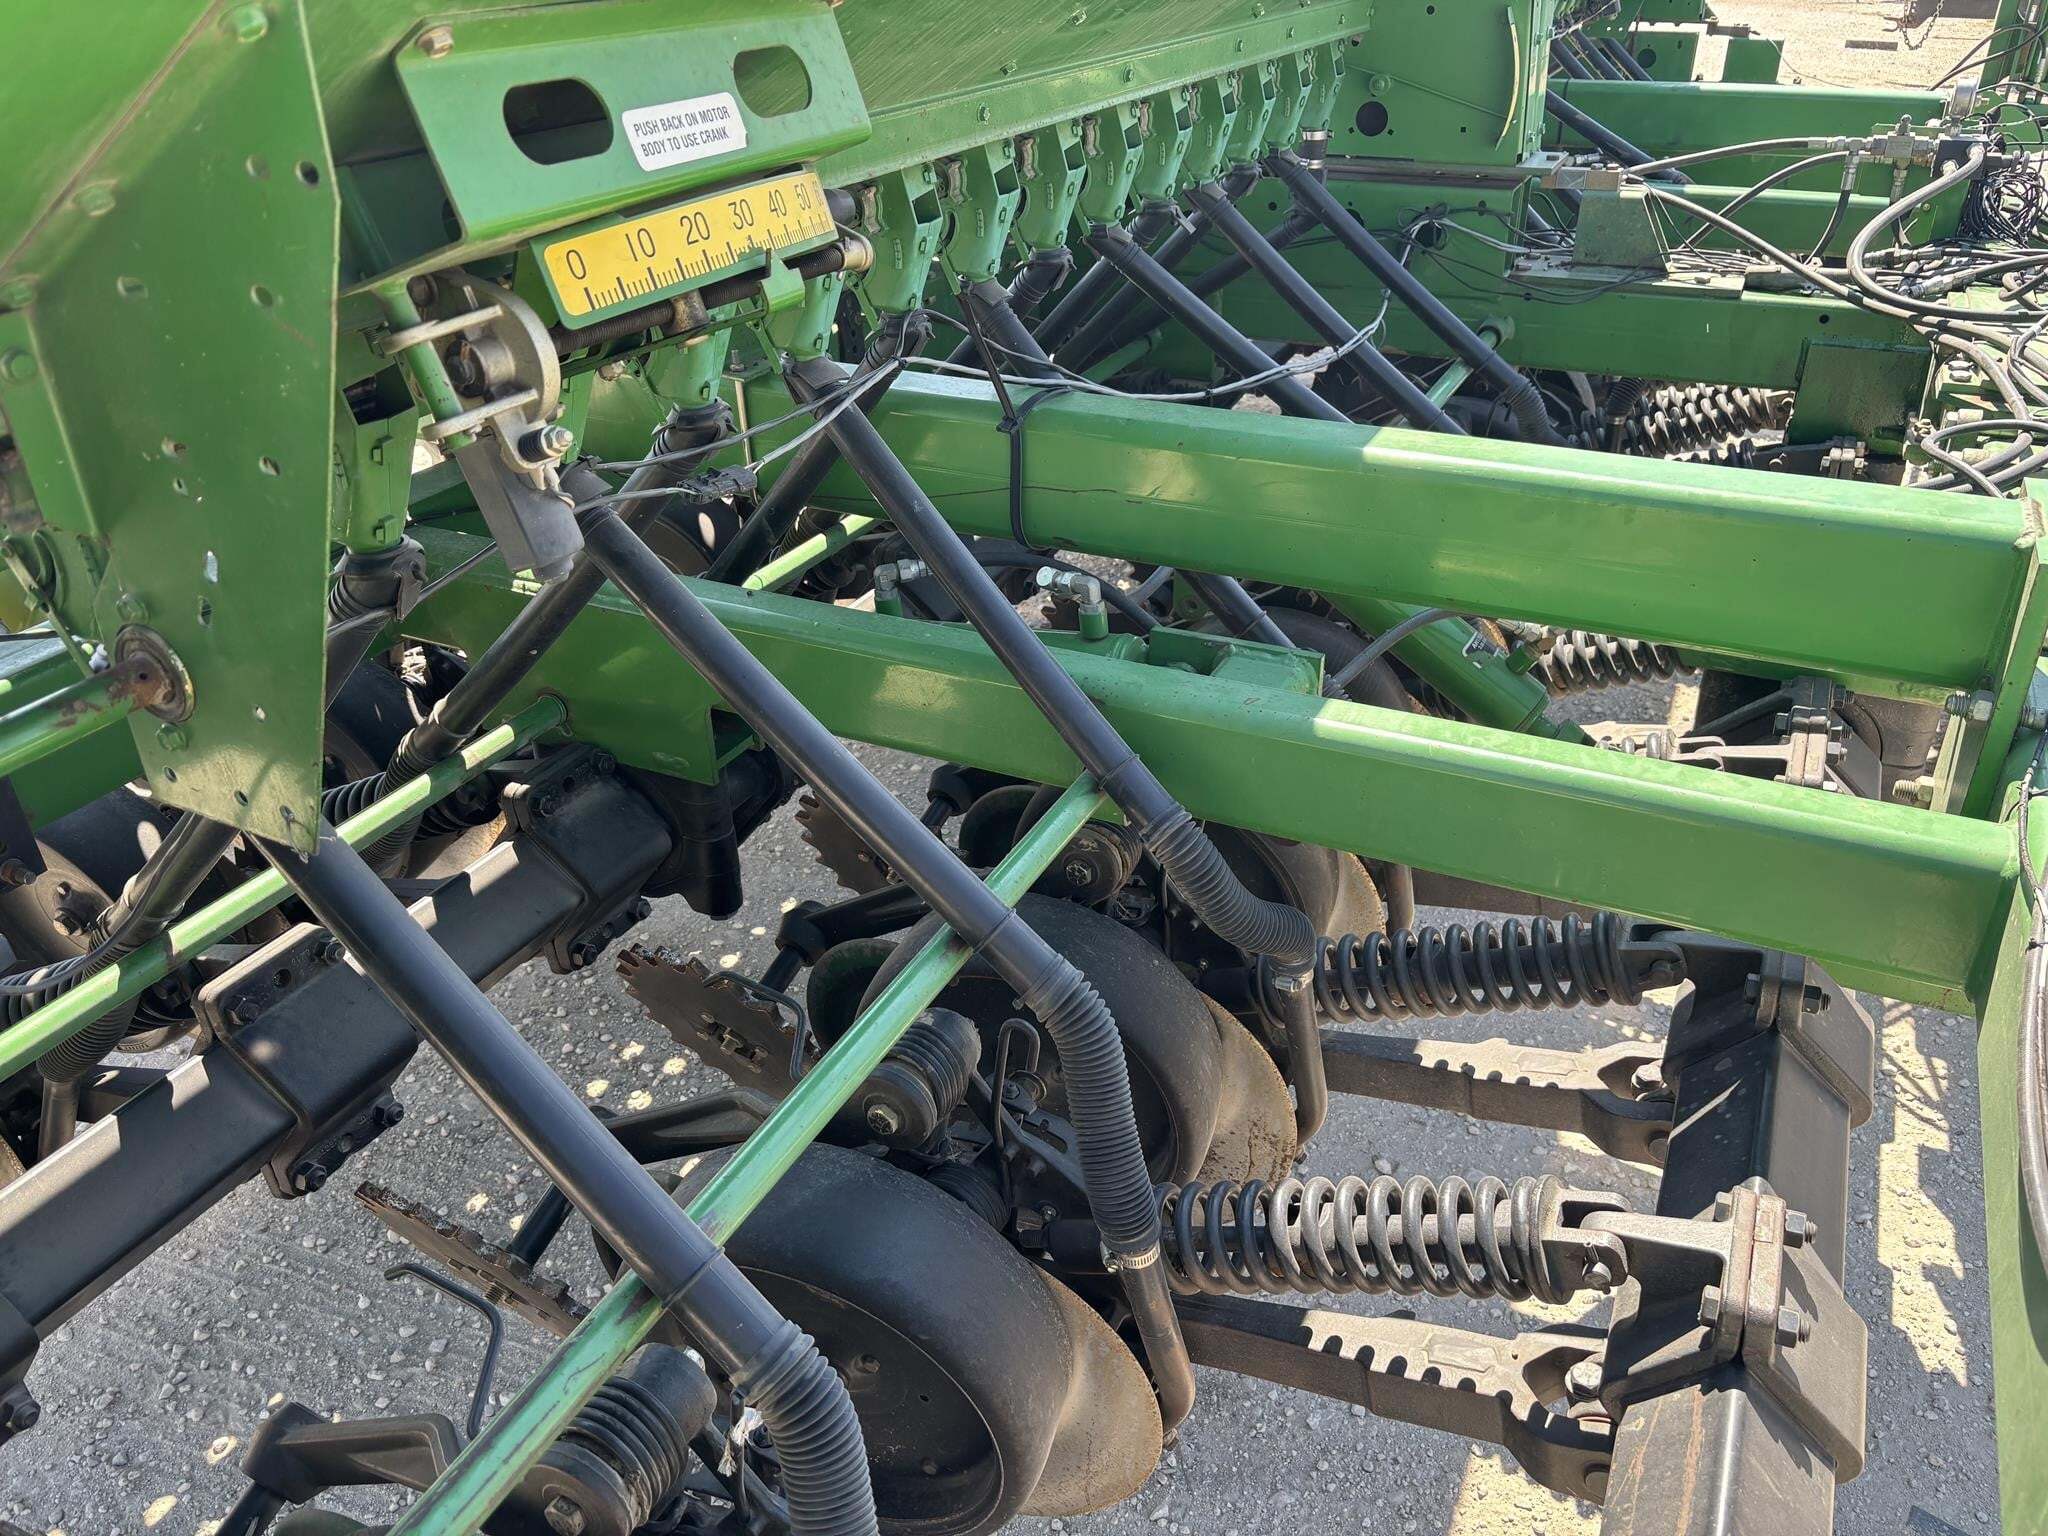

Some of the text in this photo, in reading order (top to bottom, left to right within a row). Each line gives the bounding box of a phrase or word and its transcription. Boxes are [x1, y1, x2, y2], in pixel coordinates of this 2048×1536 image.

[633, 106, 730, 137] PUSH BACK ON MOTOR
[640, 126, 729, 157] BODY TO USE CRANK
[566, 249, 587, 280] 0
[625, 227, 656, 262] 10
[679, 211, 711, 246] 20
[727, 198, 755, 230] 30
[768, 188, 787, 218] 40
[794, 182, 812, 211] 50
